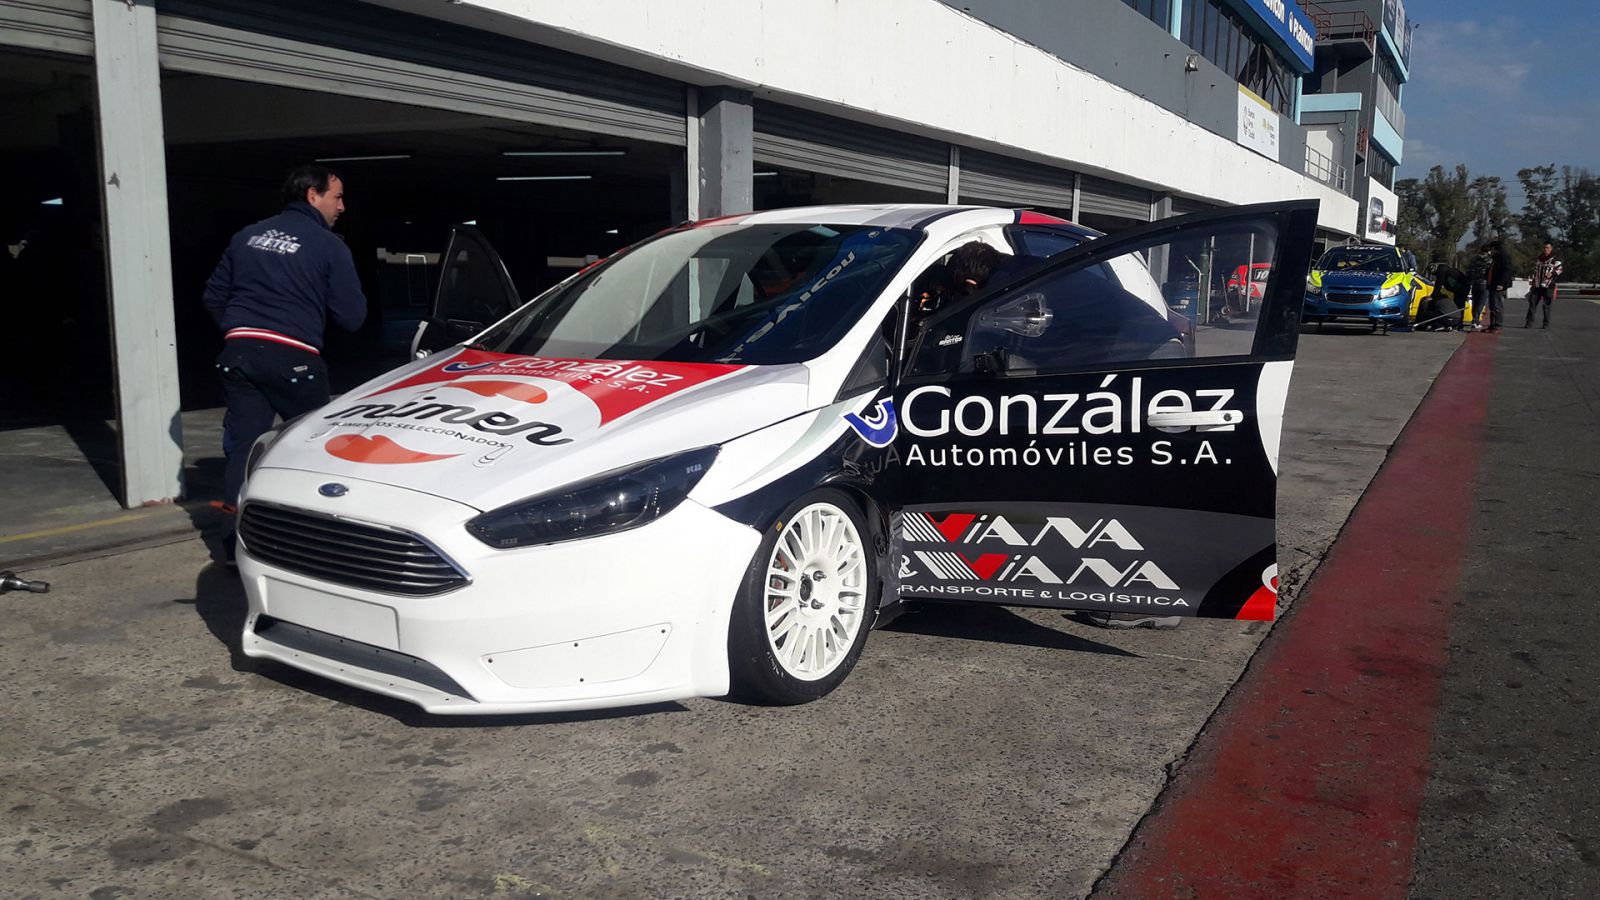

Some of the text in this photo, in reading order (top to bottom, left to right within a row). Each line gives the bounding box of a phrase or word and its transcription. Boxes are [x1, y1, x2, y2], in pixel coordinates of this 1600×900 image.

[478, 366, 651, 394] Automóviles S.A.
[499, 357, 683, 387] González
[901, 373, 1236, 438] González
[323, 396, 574, 447] mimen
[328, 420, 508, 448] ALIMENOS SELECCIONADOS
[905, 439, 1134, 467] Automóviles
[1151, 440, 1233, 466] S.A.
[1040, 590, 1053, 599] &
[1058, 591, 1190, 607] LOGÍSTICA
